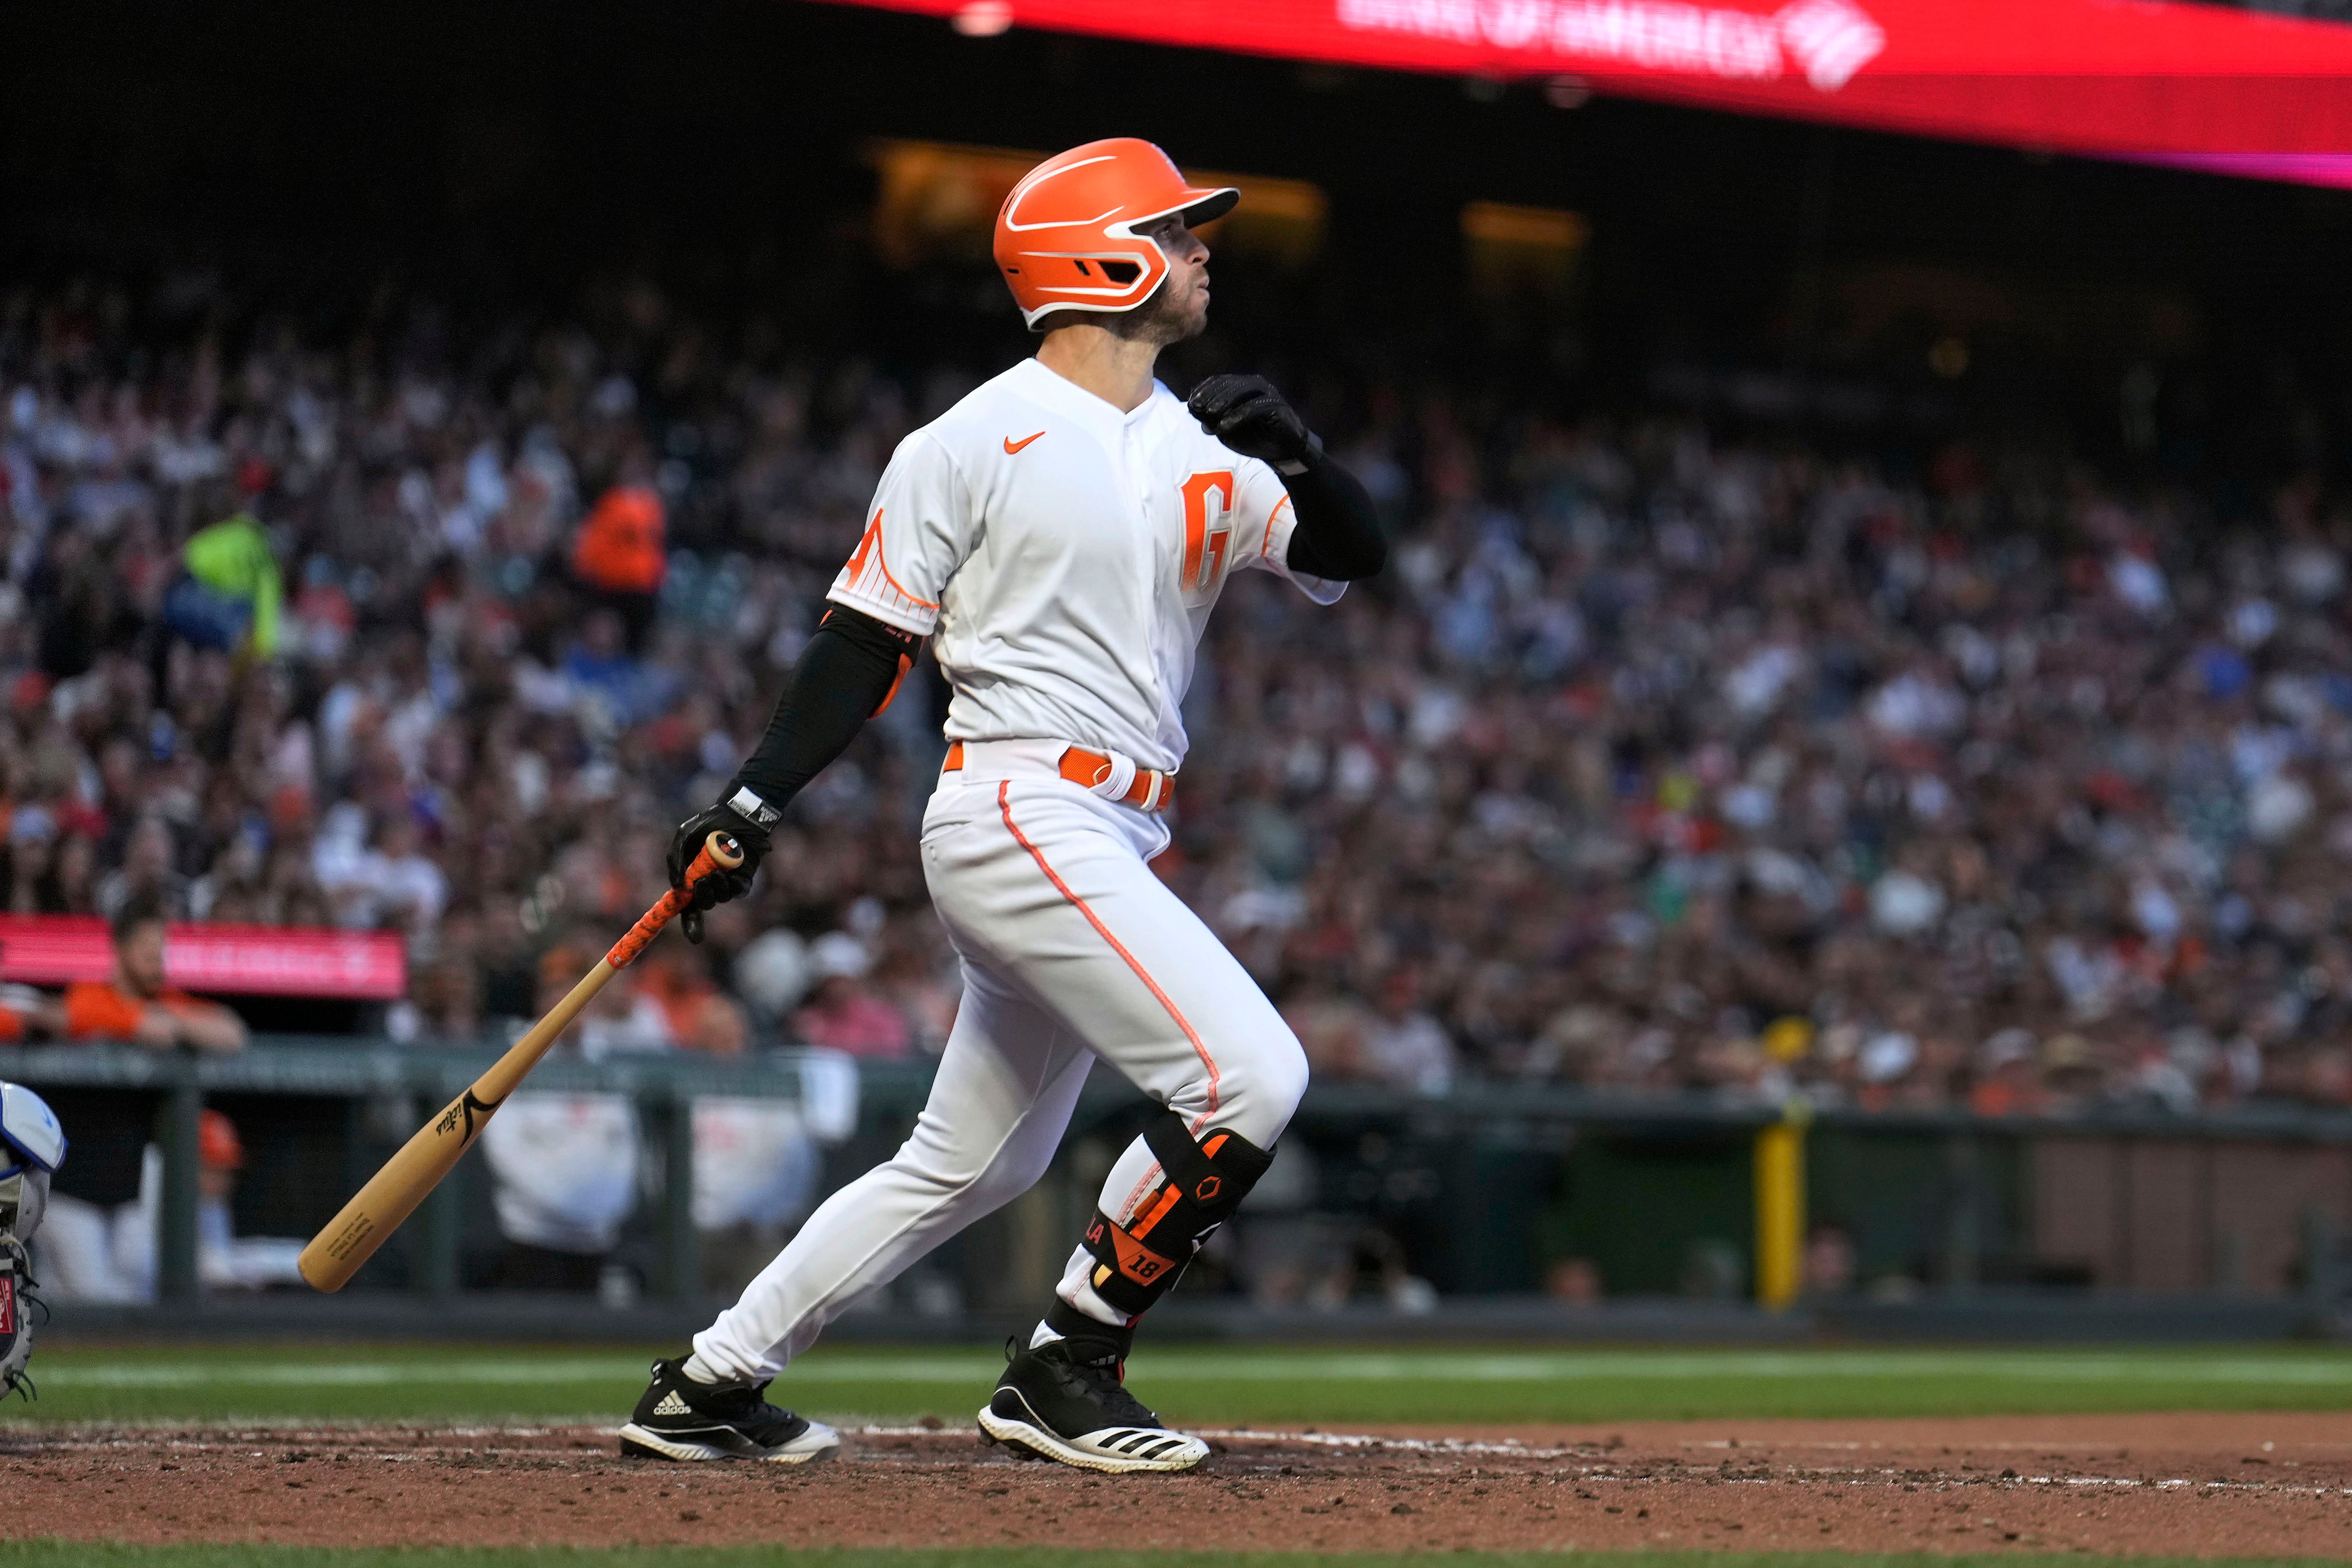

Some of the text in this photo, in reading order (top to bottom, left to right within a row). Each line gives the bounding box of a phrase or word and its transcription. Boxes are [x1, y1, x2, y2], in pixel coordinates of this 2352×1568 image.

[1178, 469, 1234, 602] G
[1128, 1255, 1160, 1278] 18
[653, 1405, 692, 1416] adidas
